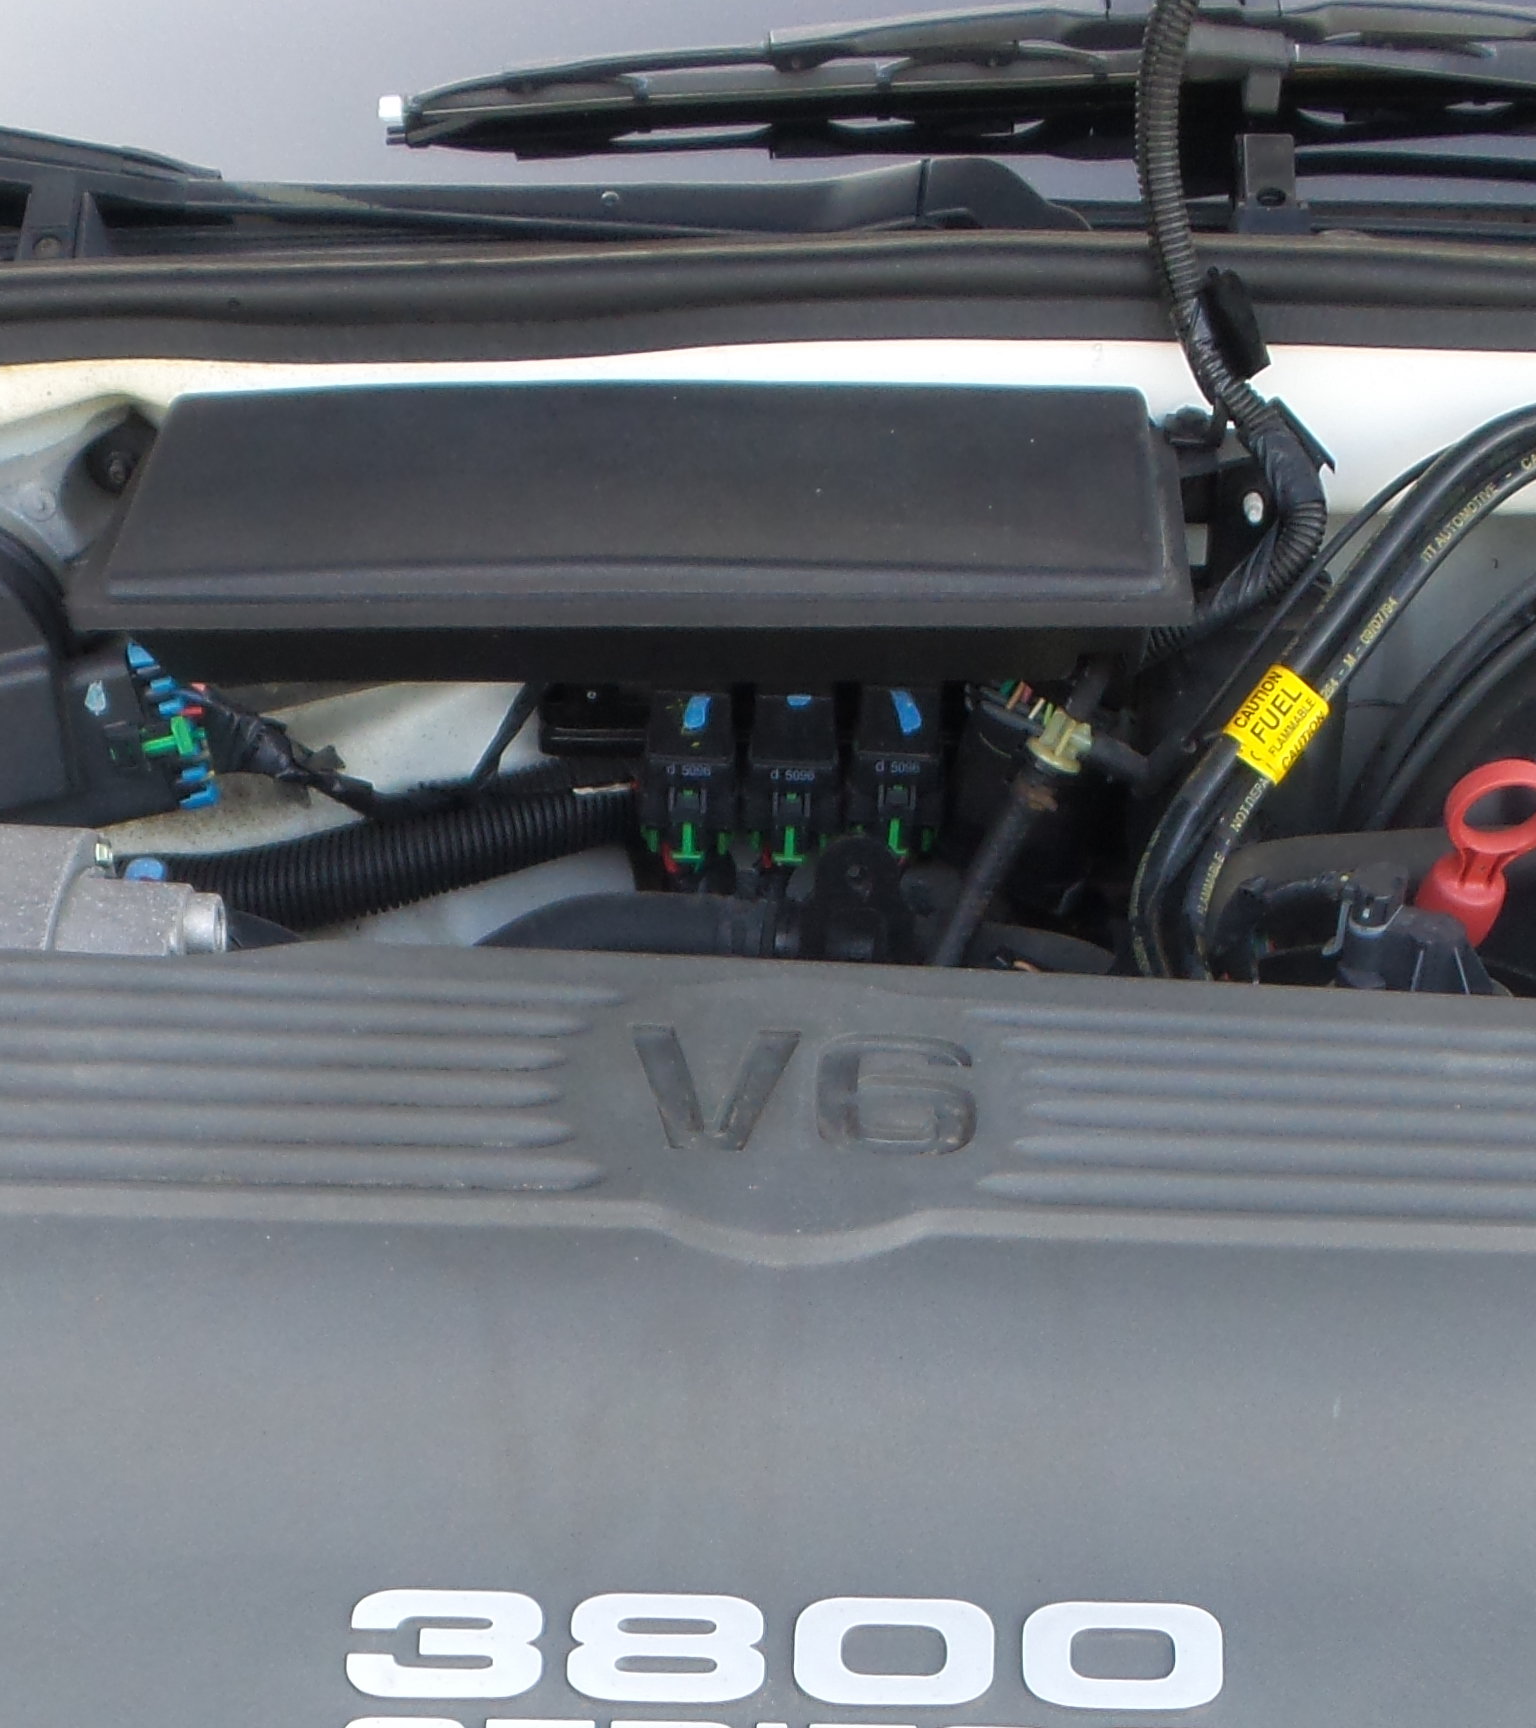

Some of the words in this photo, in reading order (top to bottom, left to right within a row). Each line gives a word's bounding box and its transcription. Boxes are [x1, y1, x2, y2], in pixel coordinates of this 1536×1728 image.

[1234, 671, 1283, 728] CAUTION
[1250, 688, 1302, 744] FUEL
[1268, 698, 1317, 755] FLAMMABLE
[631, 1023, 979, 1156] V6
[345, 1587, 1225, 1711] 3800
